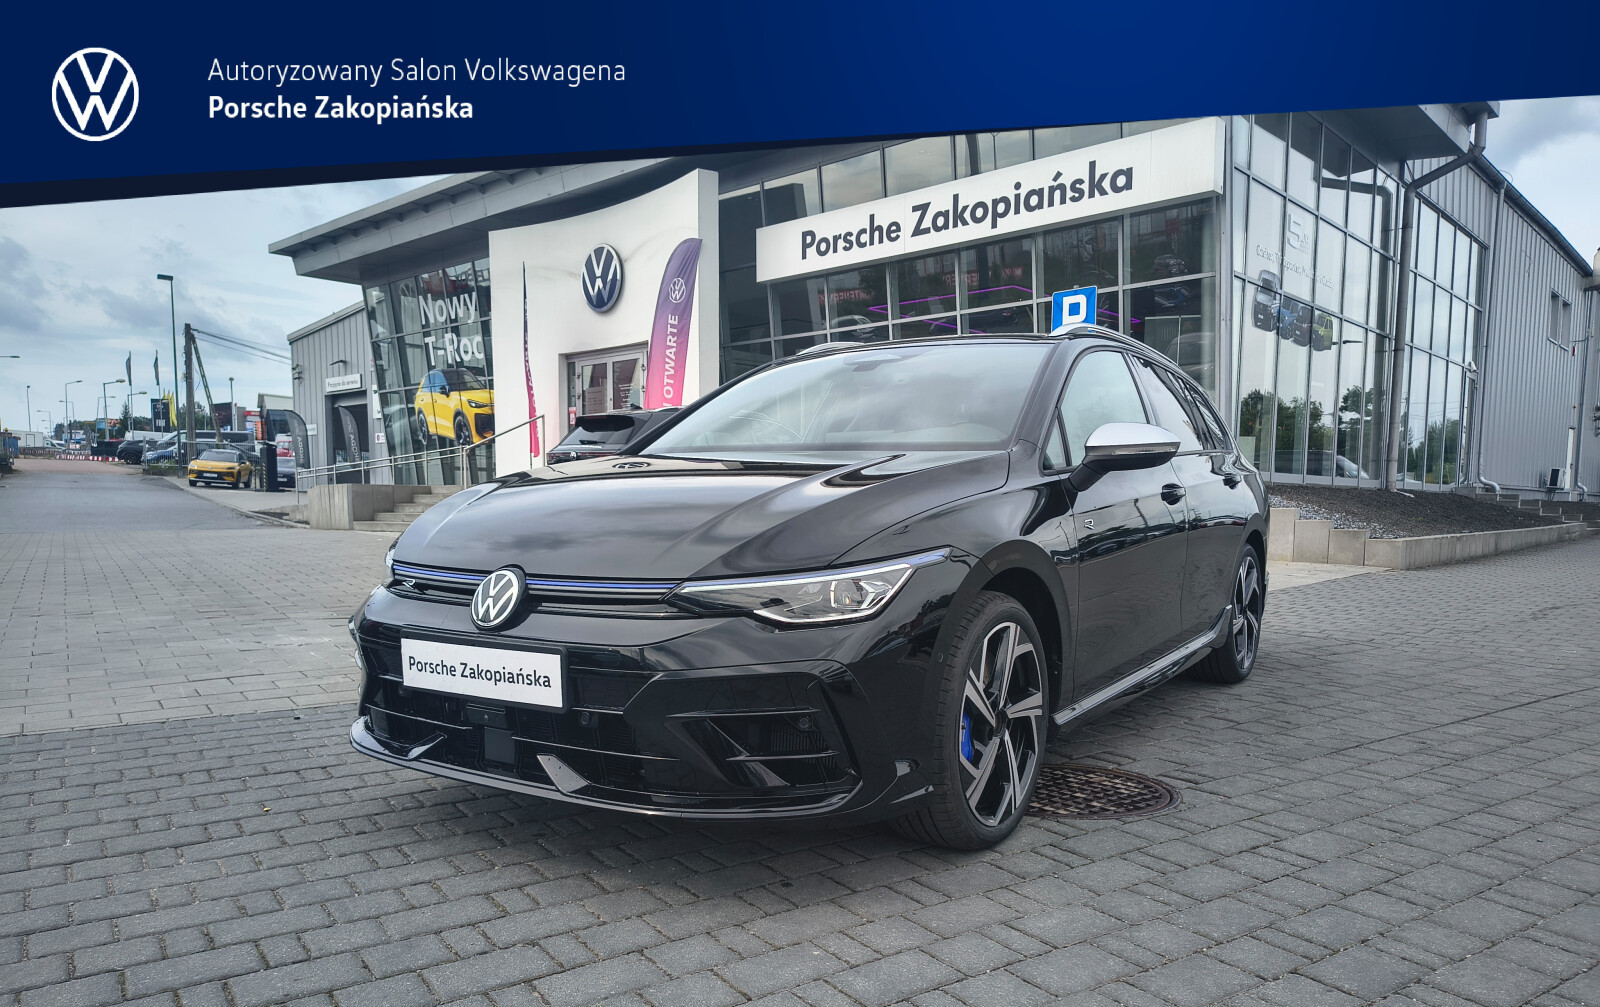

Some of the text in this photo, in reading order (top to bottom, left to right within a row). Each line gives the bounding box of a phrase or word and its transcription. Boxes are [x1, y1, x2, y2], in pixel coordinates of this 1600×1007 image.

[801, 159, 1134, 260] Porsche Zakopiańska
[418, 291, 477, 325] Nowy
[424, 332, 485, 366] T-Roc
[663, 313, 679, 399] OTWARTE
[408, 655, 552, 688] Porsche Zakopiańska
